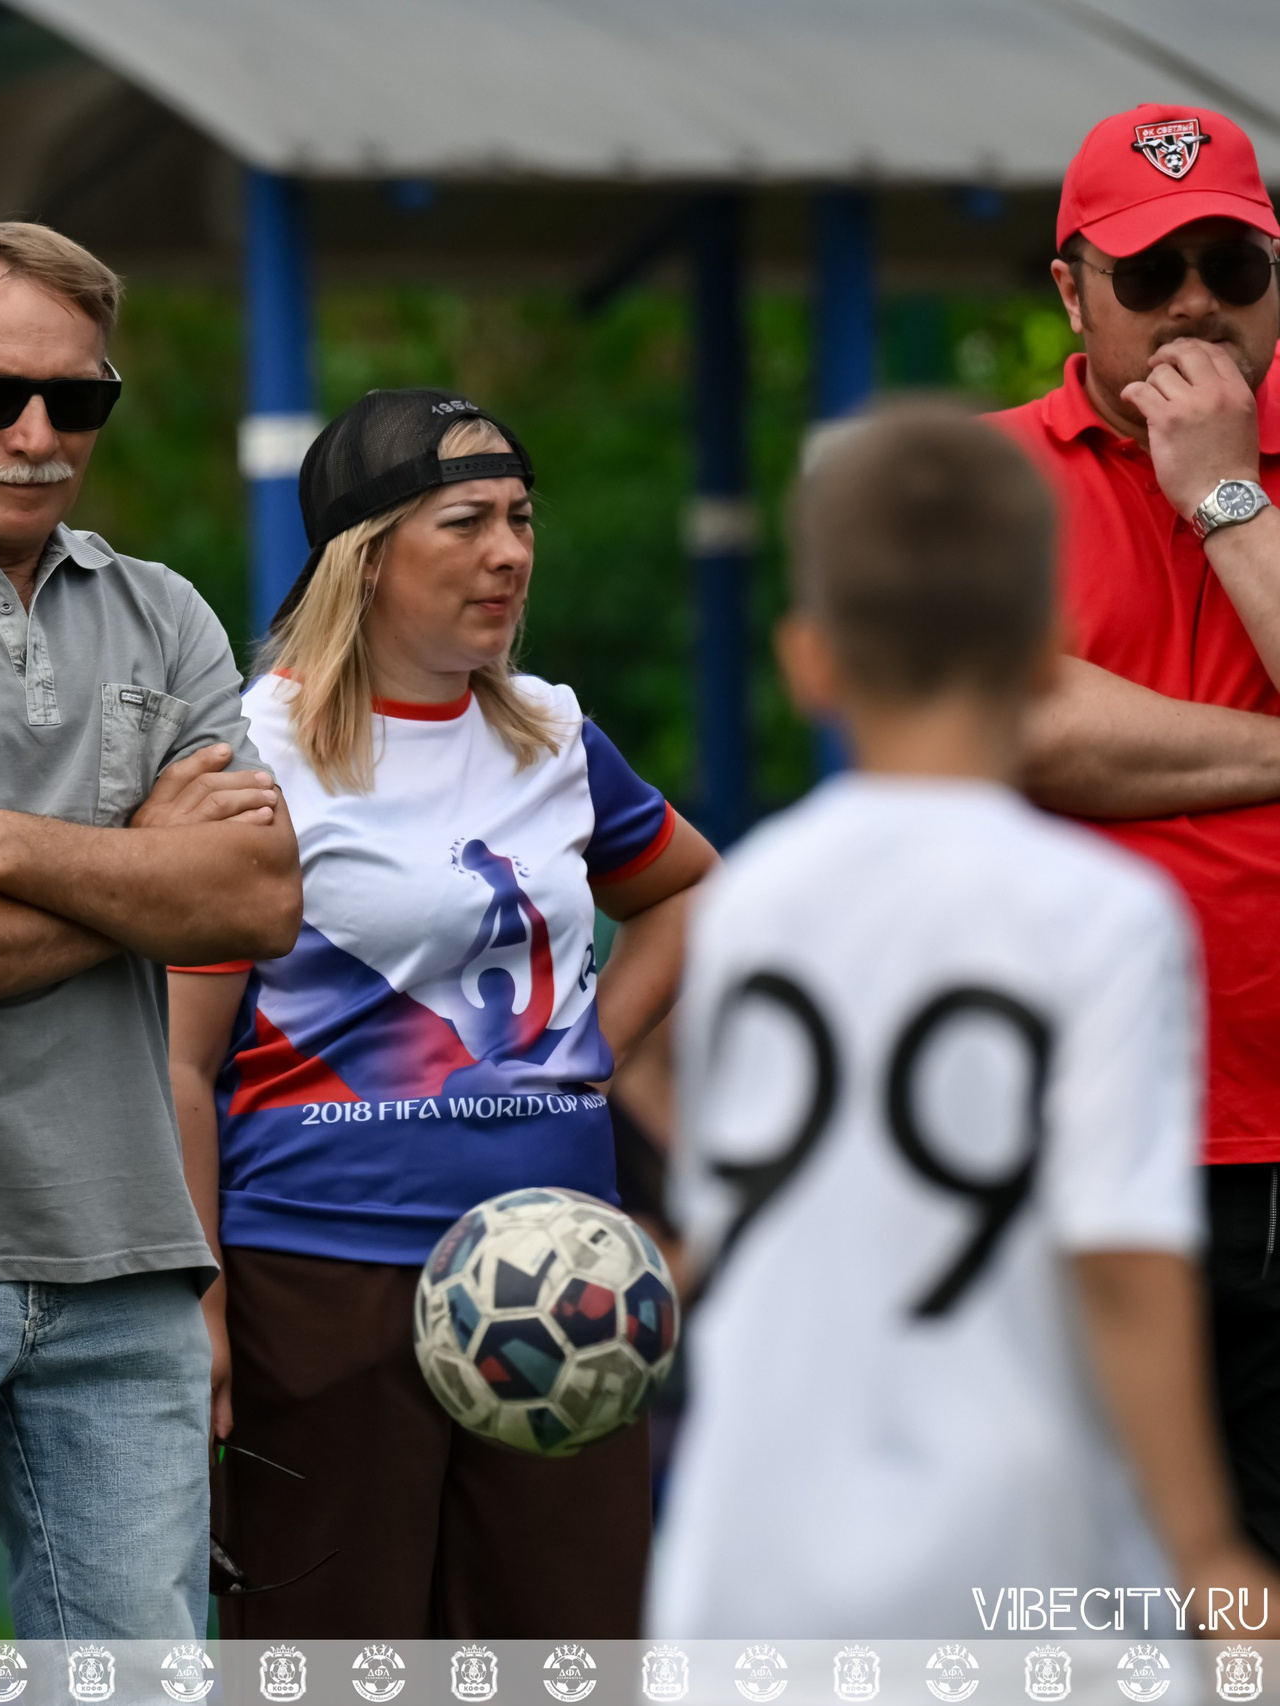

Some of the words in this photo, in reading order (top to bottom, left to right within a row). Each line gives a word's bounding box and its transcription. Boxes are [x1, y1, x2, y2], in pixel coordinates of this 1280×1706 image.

[1142, 129, 1155, 137] ФК
[1156, 122, 1194, 135] СВЕТЛЫЙ
[301, 1102, 373, 1126] 2018
[378, 1098, 442, 1121] FIFA
[448, 1095, 544, 1119] WORLD
[545, 1093, 578, 1114] CUP
